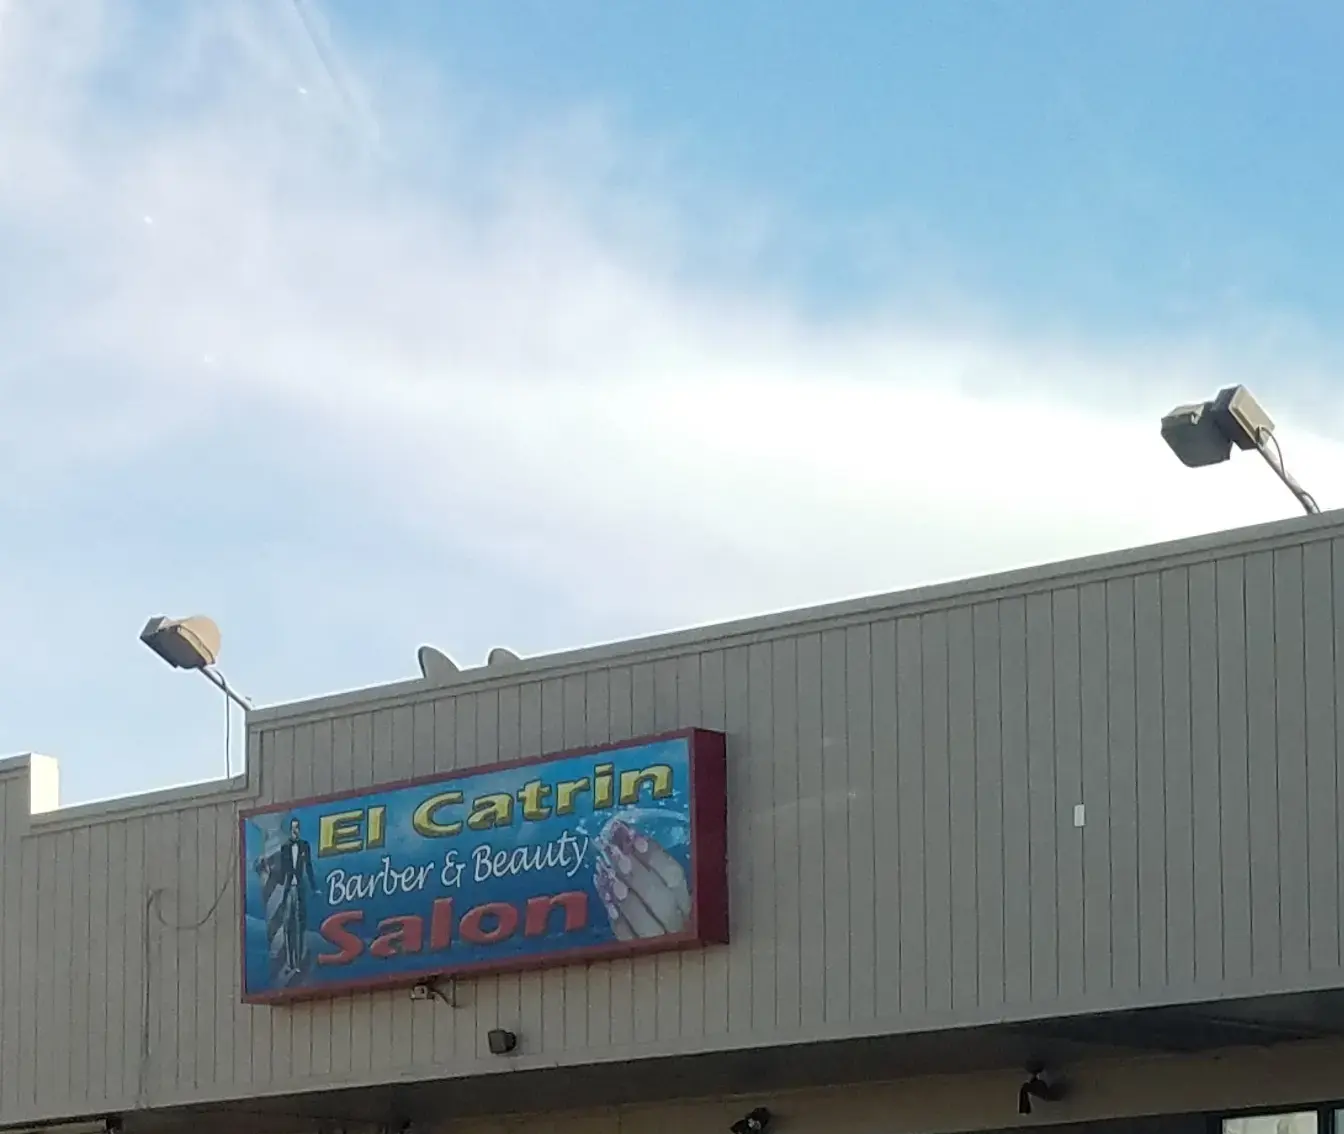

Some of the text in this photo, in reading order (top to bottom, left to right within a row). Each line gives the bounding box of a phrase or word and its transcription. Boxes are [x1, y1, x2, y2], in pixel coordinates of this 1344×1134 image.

[318, 762, 676, 858] El Catrin
[327, 830, 590, 905] Barber & Beauty
[317, 889, 589, 967] Salon
